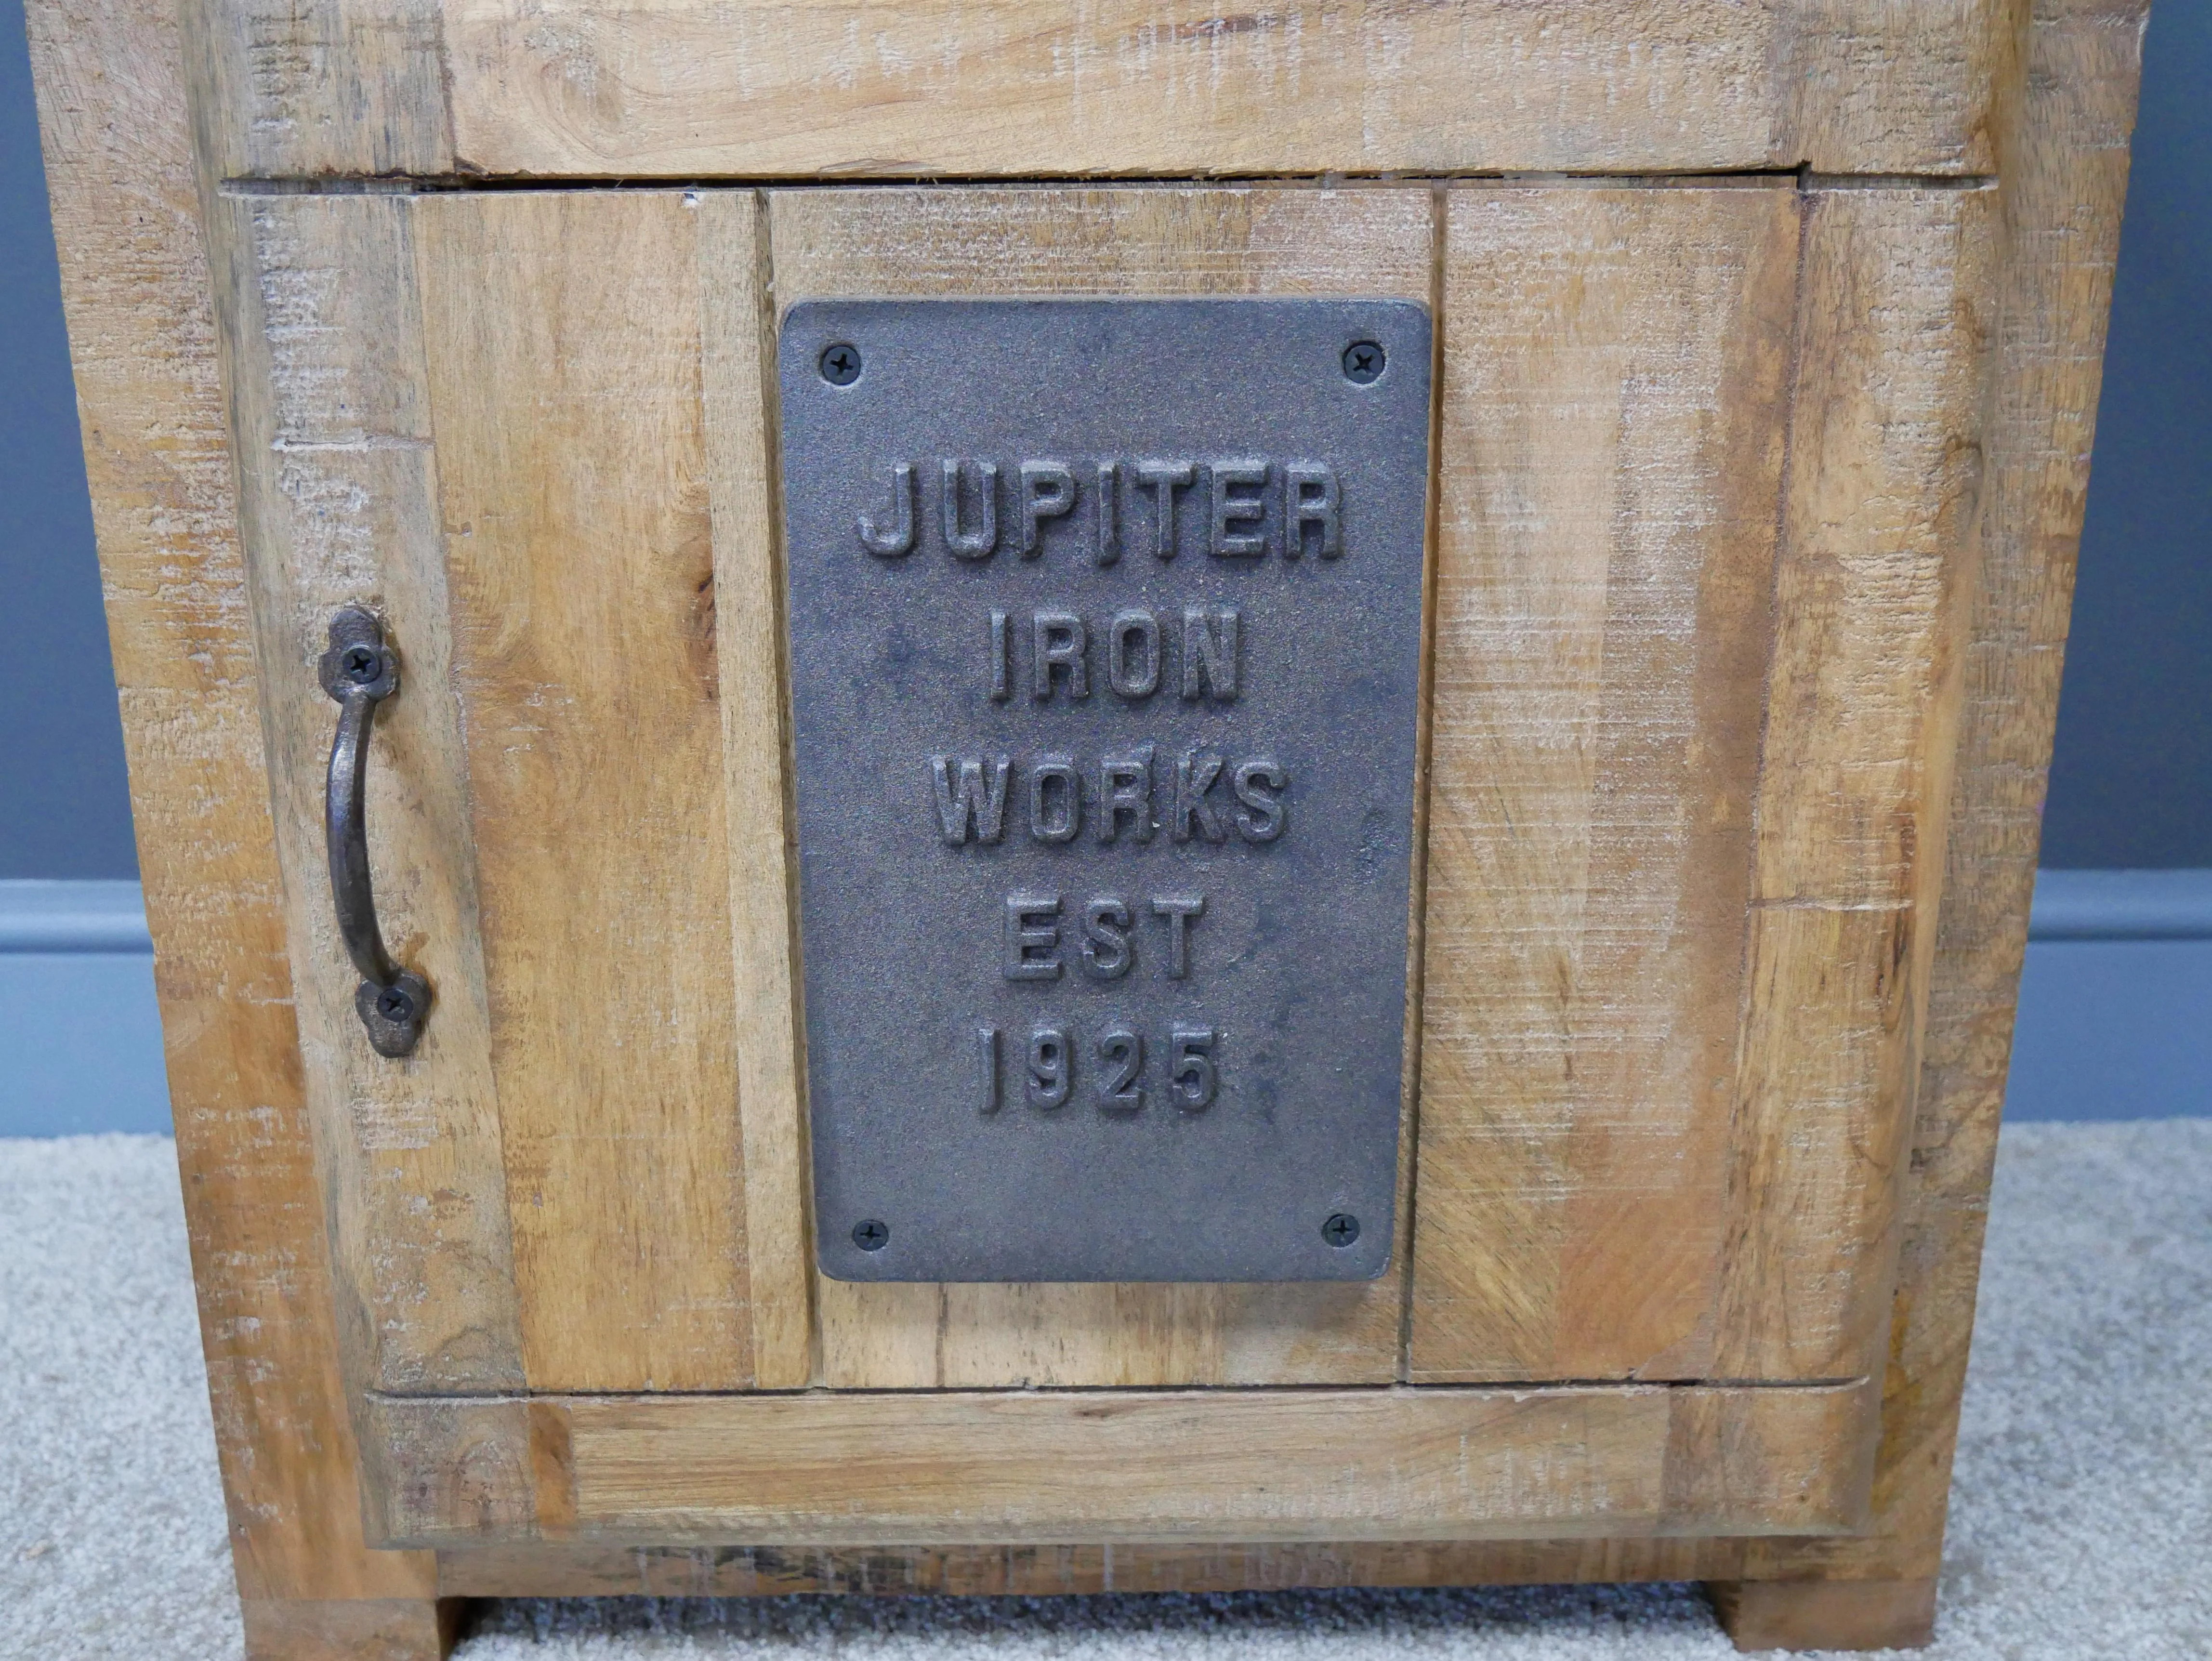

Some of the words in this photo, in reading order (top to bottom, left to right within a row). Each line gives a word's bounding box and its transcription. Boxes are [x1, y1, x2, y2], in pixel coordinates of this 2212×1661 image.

[857, 459, 1344, 565] JUPITER
[988, 608, 1242, 701] IRON
[932, 749, 1287, 845] WORKS
[1004, 892, 1206, 981] EST
[978, 1021, 1219, 1115] 1925
